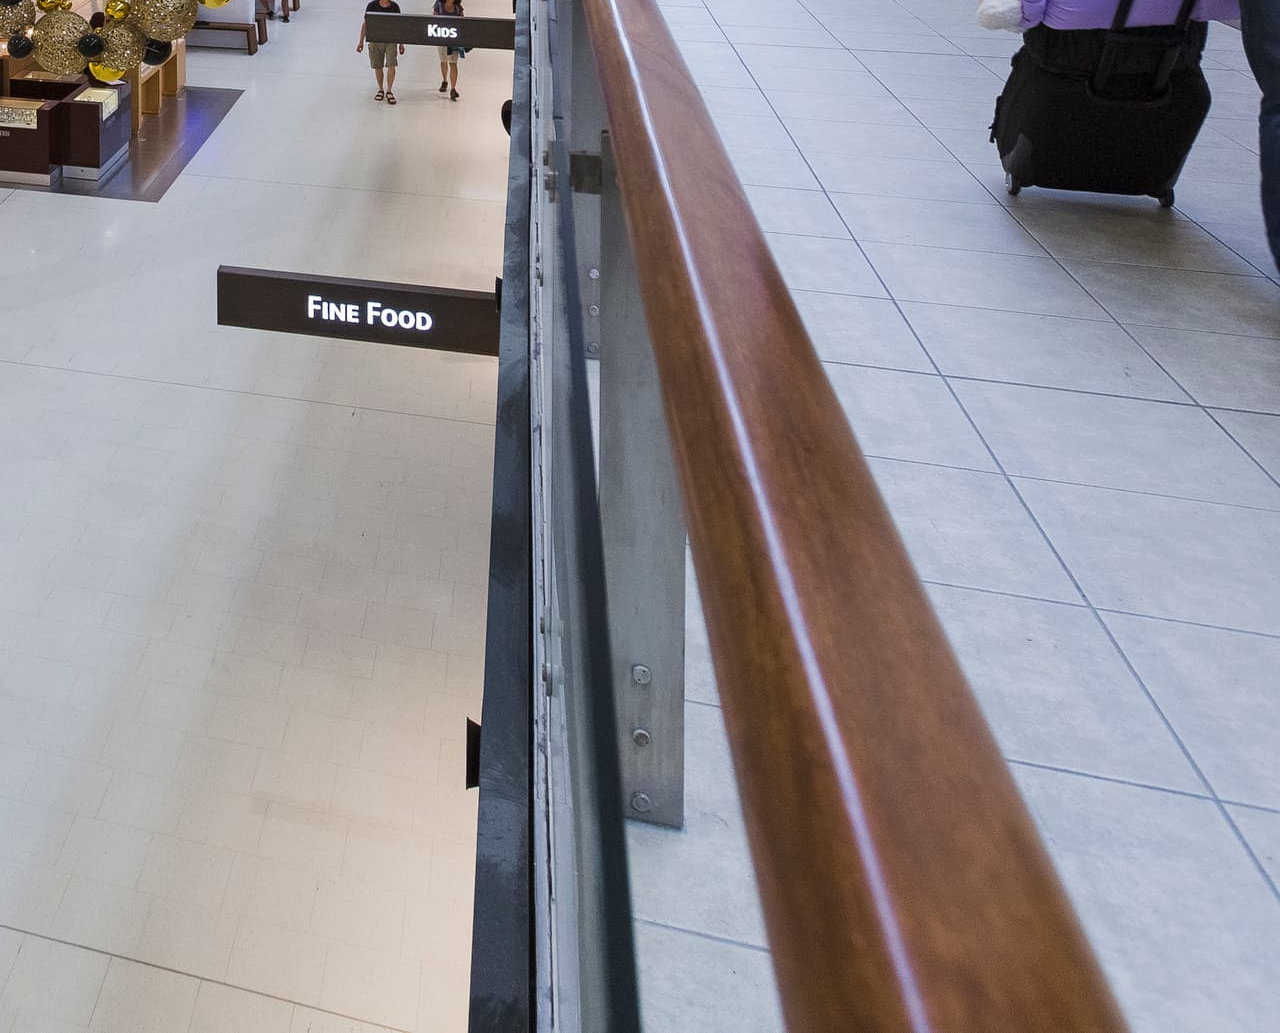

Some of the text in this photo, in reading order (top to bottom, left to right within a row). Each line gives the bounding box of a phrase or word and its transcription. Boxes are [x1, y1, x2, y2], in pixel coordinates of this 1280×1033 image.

[427, 24, 458, 38] KIDS
[307, 295, 433, 332] FINE FOOD
